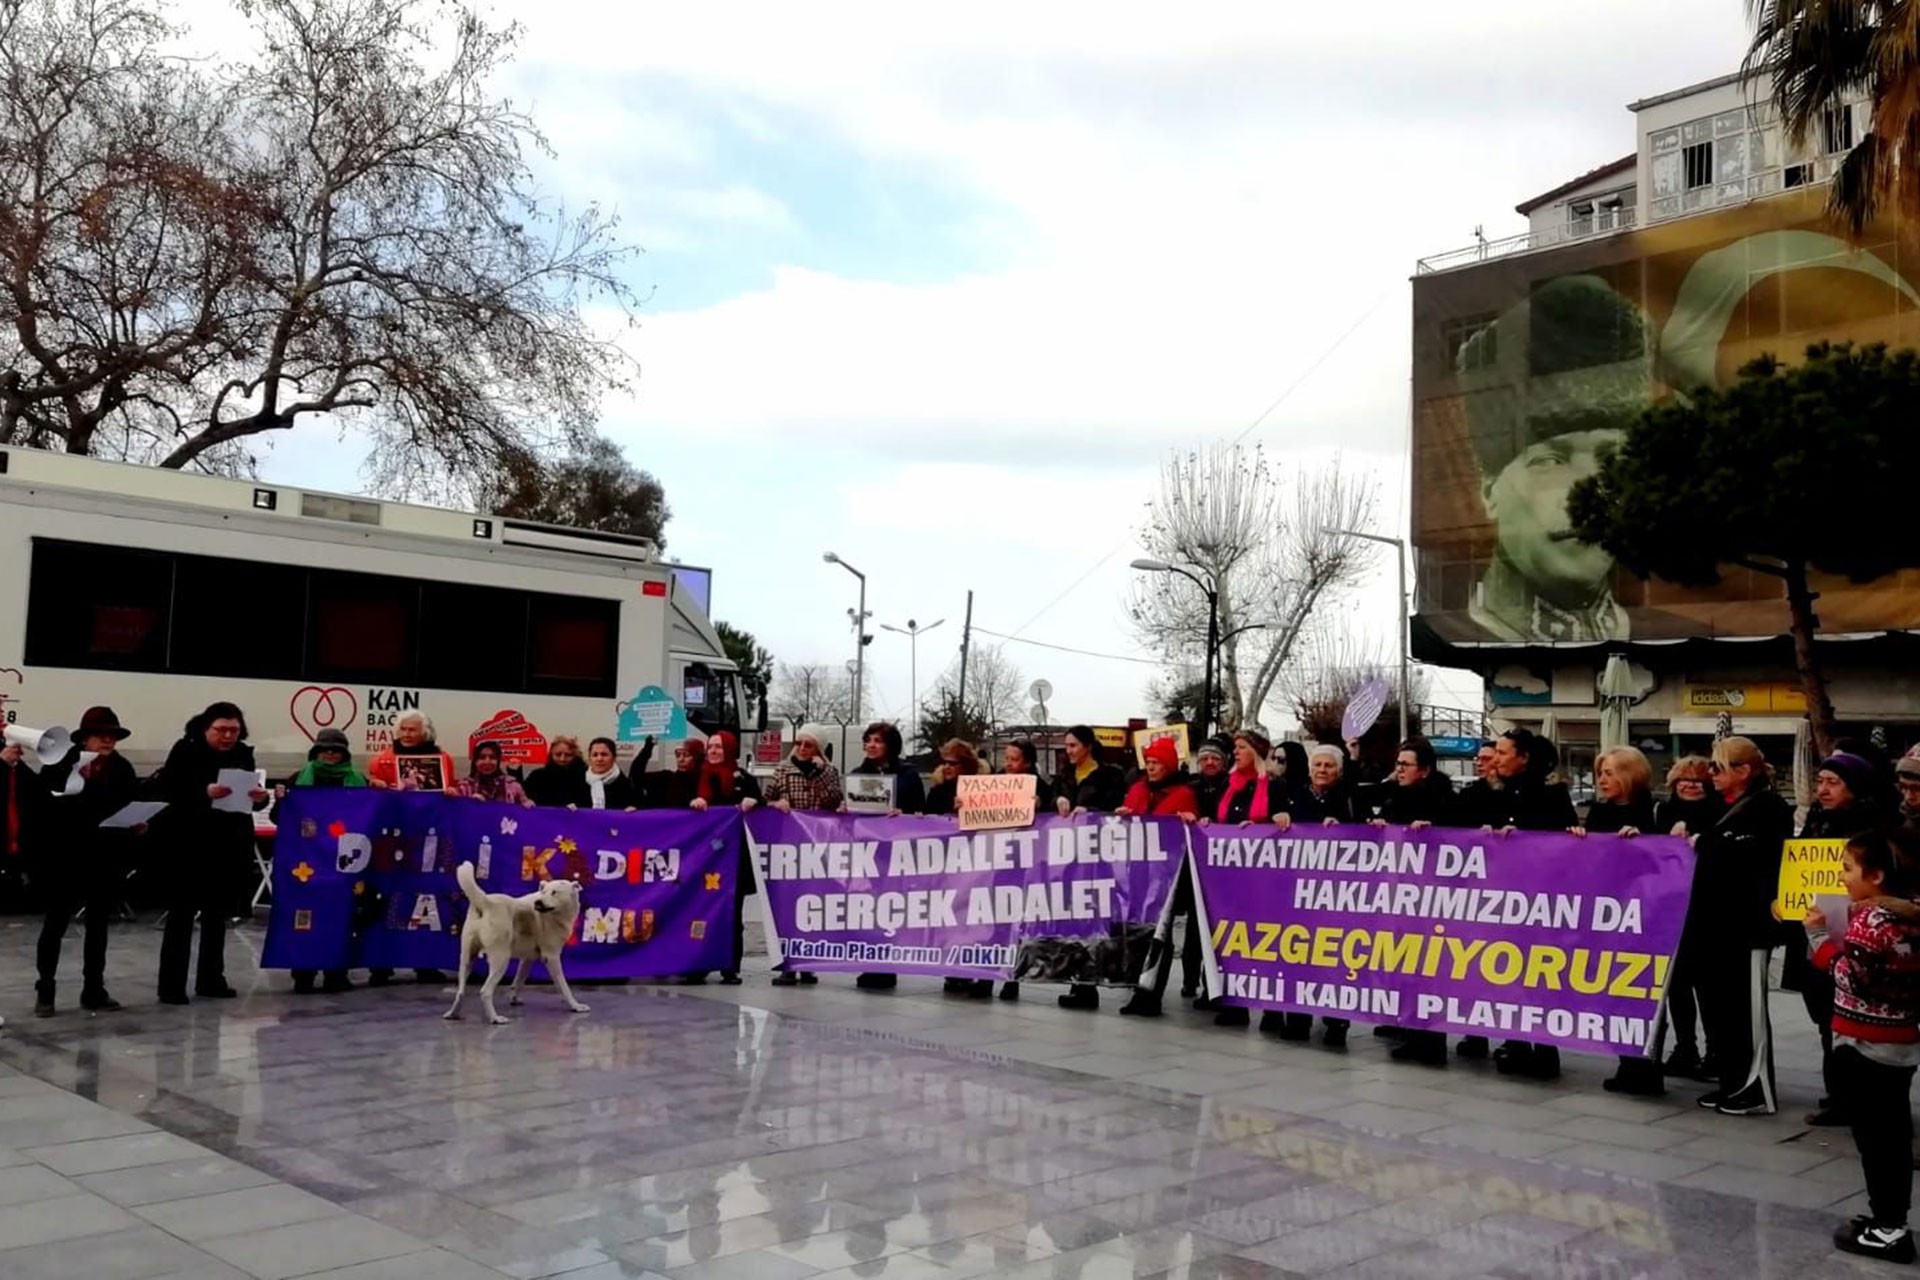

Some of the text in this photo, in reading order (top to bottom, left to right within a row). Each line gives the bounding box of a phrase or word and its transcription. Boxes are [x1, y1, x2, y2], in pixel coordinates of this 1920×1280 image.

[368, 688, 420, 711] KAN
[967, 792, 1015, 808] KADIN
[754, 816, 1168, 881] ERKEK ADALET DEĞİL
[1207, 837, 1487, 879] HAYATIMIZDAN DA
[795, 878, 1116, 937] GERÇEK ADALET
[1294, 878, 1642, 934] HAKLARIMIZDAN DA
[789, 938, 846, 960] Kadın
[847, 940, 942, 965] Platformu
[1295, 981, 1400, 1016] KADIN
[1417, 993, 1656, 1047] PLATFORM
